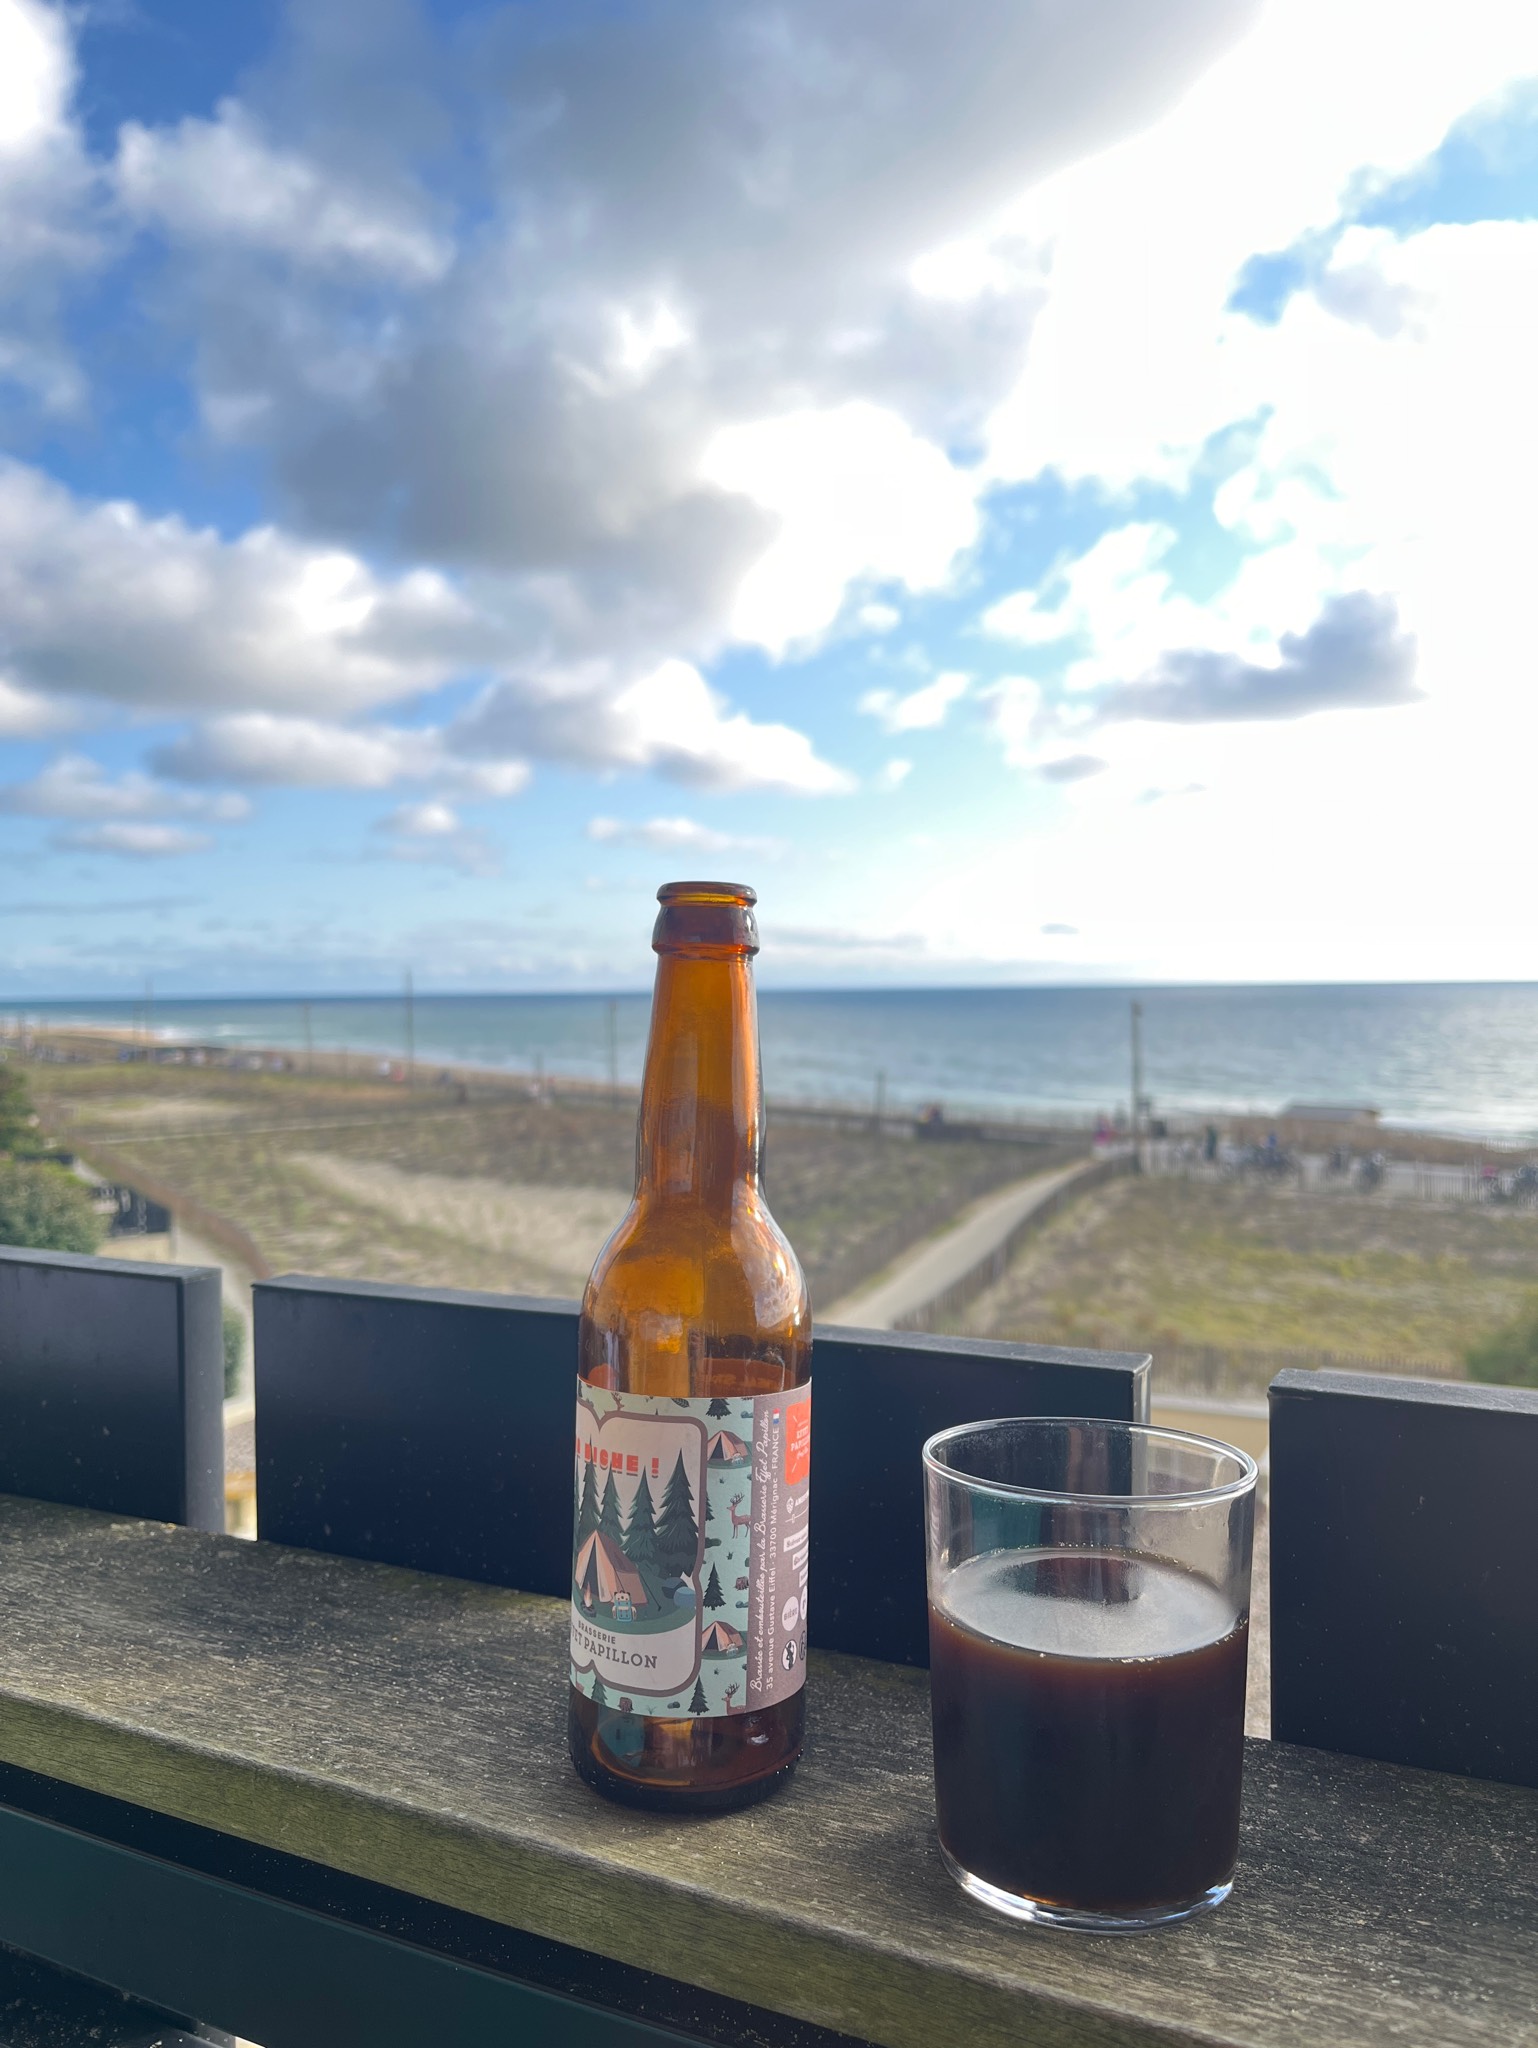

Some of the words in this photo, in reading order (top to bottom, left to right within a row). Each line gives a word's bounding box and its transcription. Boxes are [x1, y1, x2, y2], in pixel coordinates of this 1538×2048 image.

[755, 1410, 771, 1457] Papillon
[771, 1427, 779, 1469] FRANCE
[755, 1458, 771, 1483] Effet
[753, 1485, 768, 1535] Brasserie
[770, 1477, 779, 1524] Mérignac
[756, 1538, 766, 1550] la
[769, 1527, 777, 1559] 33700
[759, 1553, 768, 1572] par
[768, 1567, 776, 1592] Eiffel
[767, 1595, 776, 1635] Gustave
[578, 1620, 616, 1644] BRASSERIE
[754, 1636, 763, 1648] et
[584, 1636, 657, 1669] PAPILLON
[766, 1676, 774, 1690] 35
